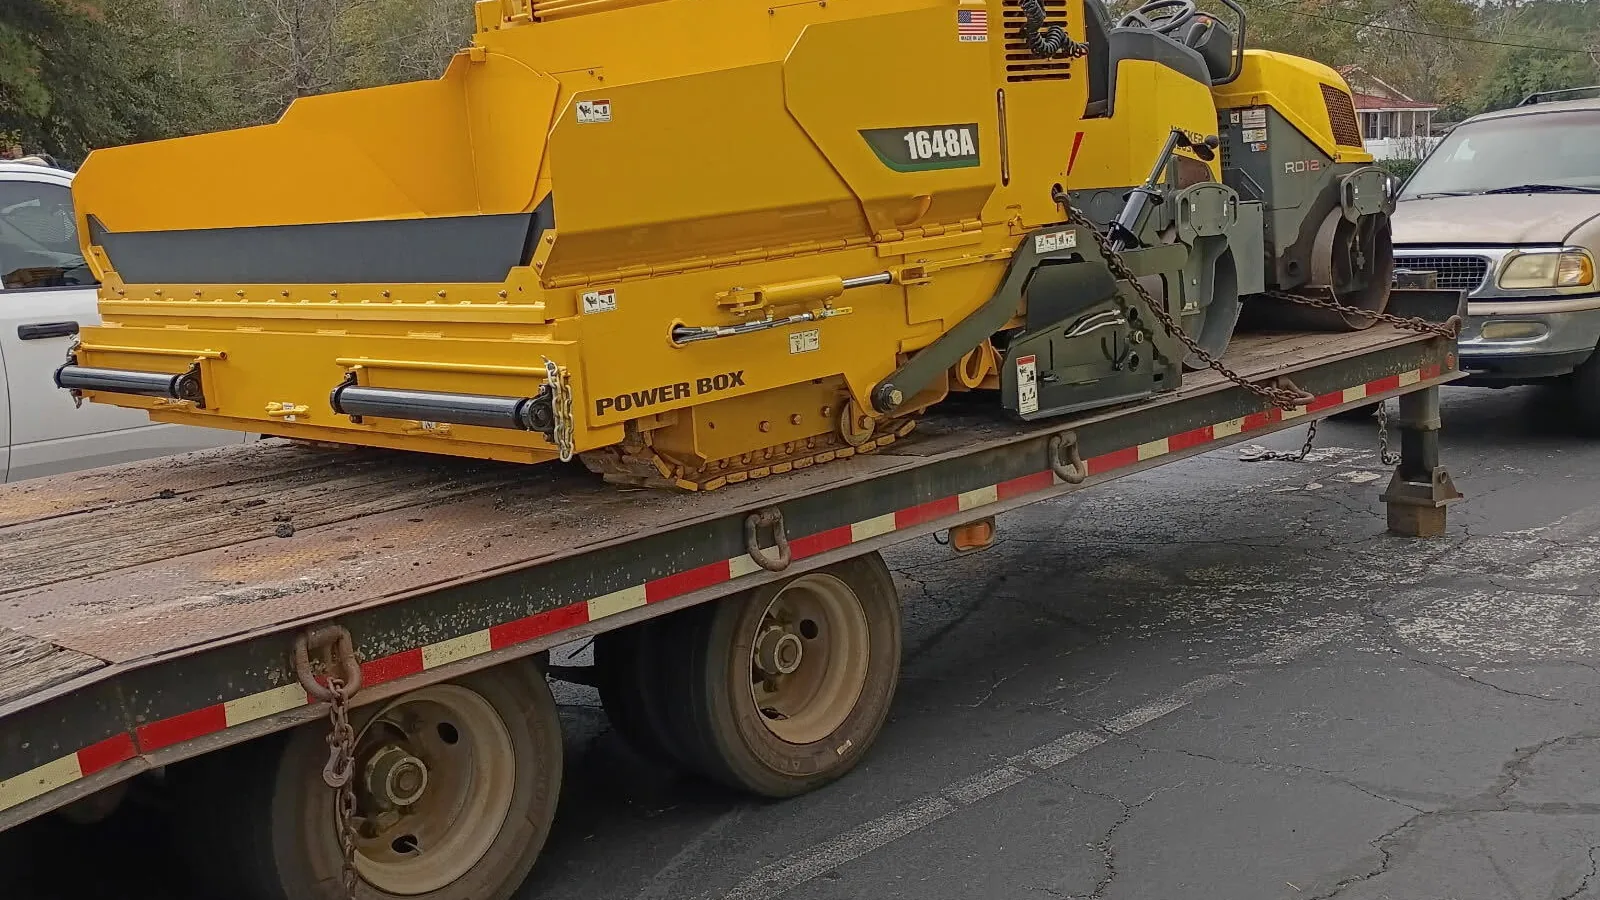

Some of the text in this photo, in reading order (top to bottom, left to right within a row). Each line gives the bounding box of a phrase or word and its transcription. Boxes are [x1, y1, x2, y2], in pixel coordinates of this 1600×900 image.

[904, 129, 975, 159] 1648A
[1285, 160, 1320, 173] RD12
[596, 370, 745, 416] POWER BOX
